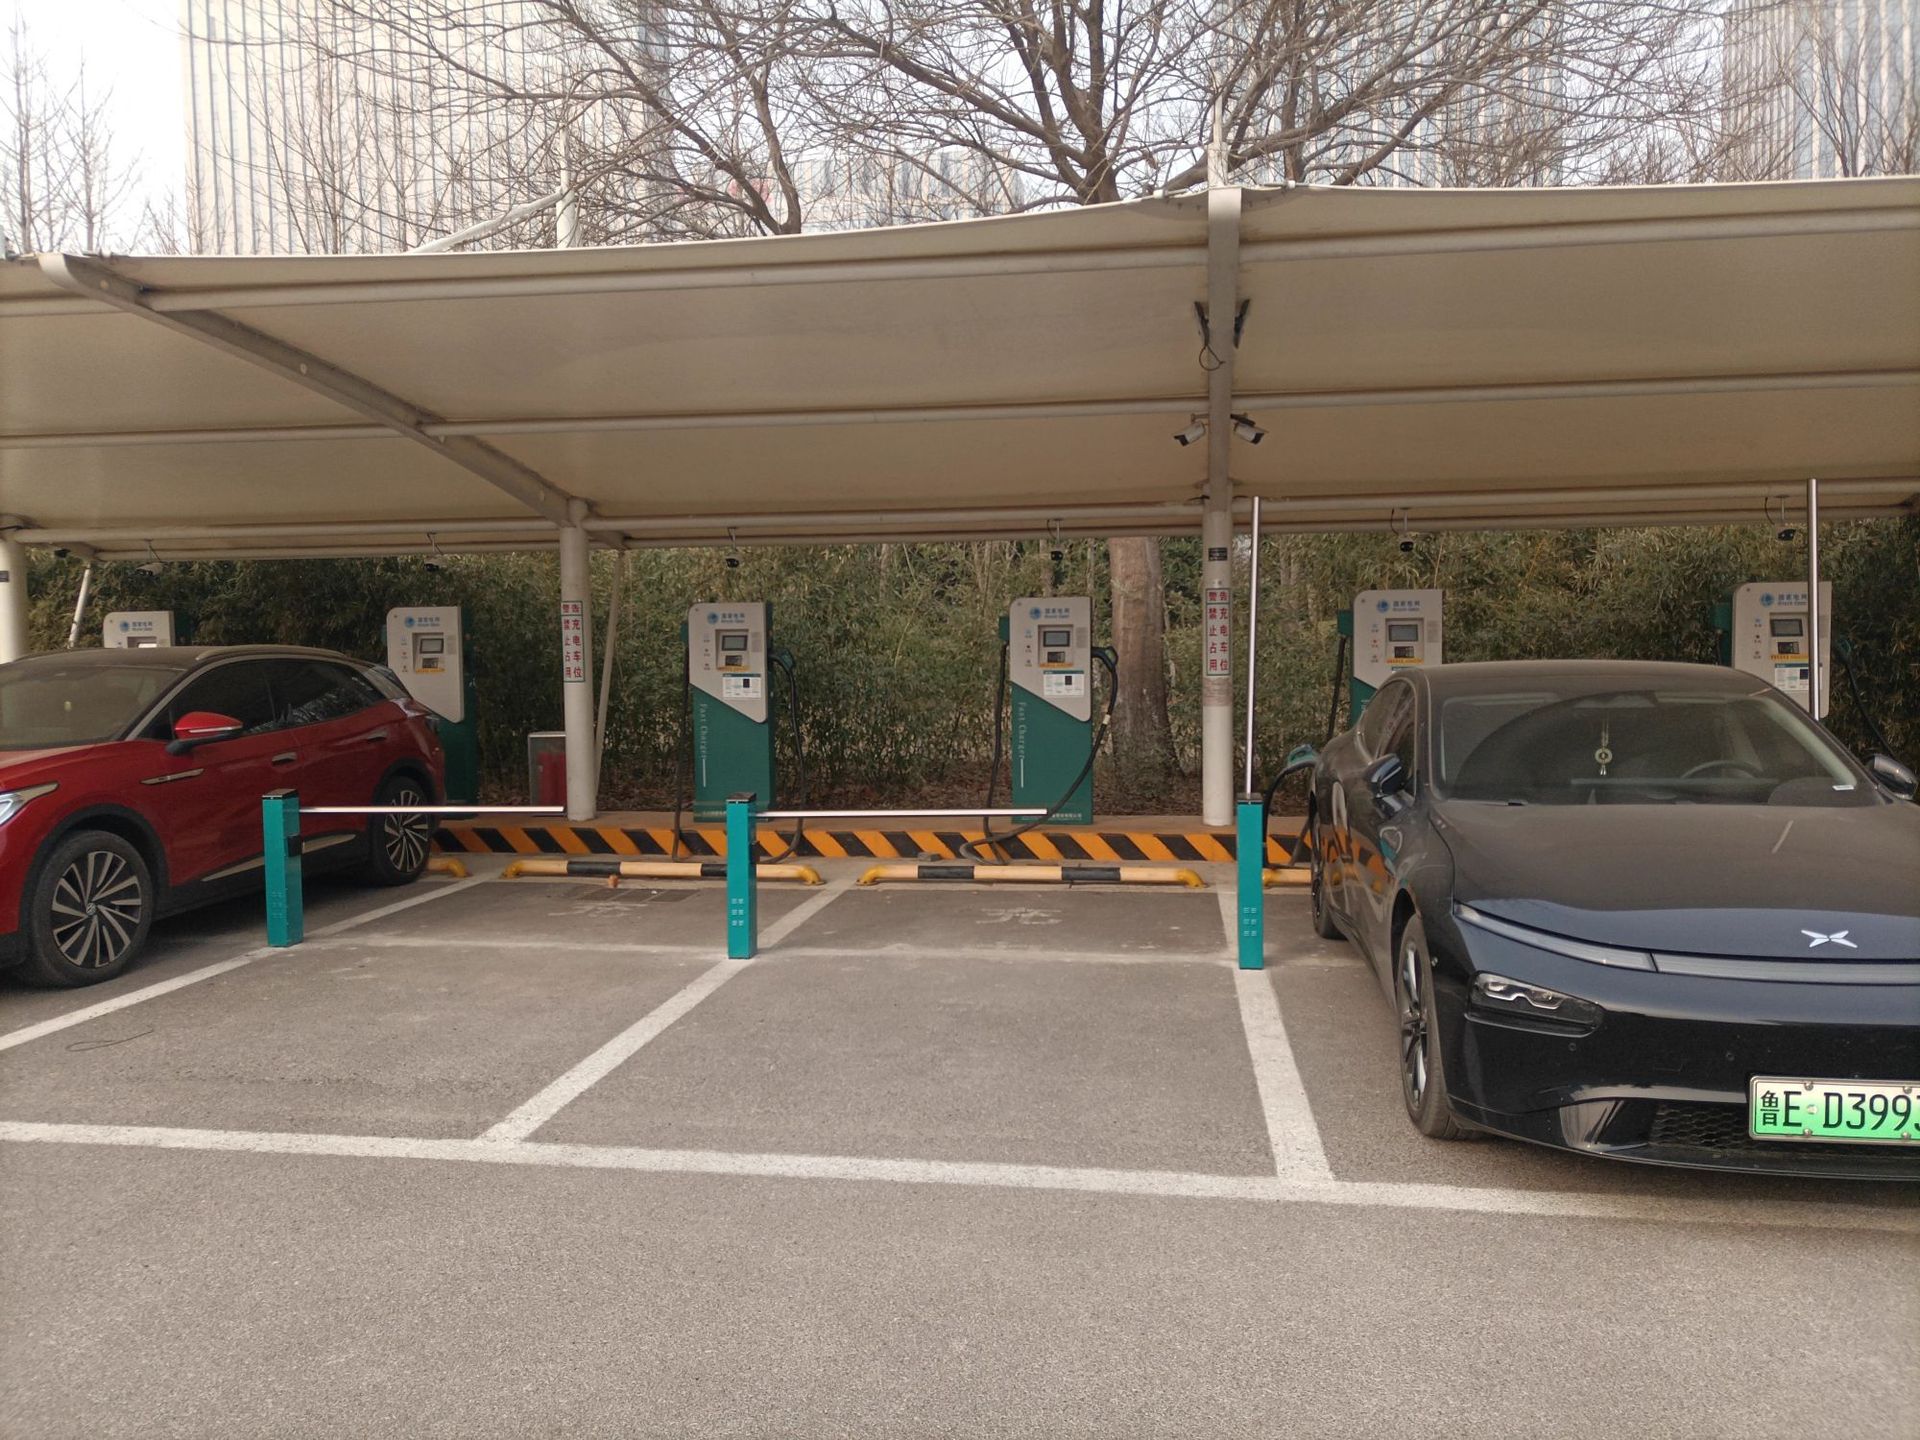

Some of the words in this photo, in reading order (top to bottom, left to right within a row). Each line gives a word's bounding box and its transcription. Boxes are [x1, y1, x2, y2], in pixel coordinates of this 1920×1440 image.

[1208, 591, 1228, 601] 警告
[572, 618, 583, 679] 充电车位
[1208, 607, 1218, 672] 禁止占用
[1219, 607, 1229, 672] 充电车位
[1018, 702, 1027, 721] Fast
[1018, 724, 1027, 760] Charger
[1760, 1089, 1920, 1131] 鲁ED399
